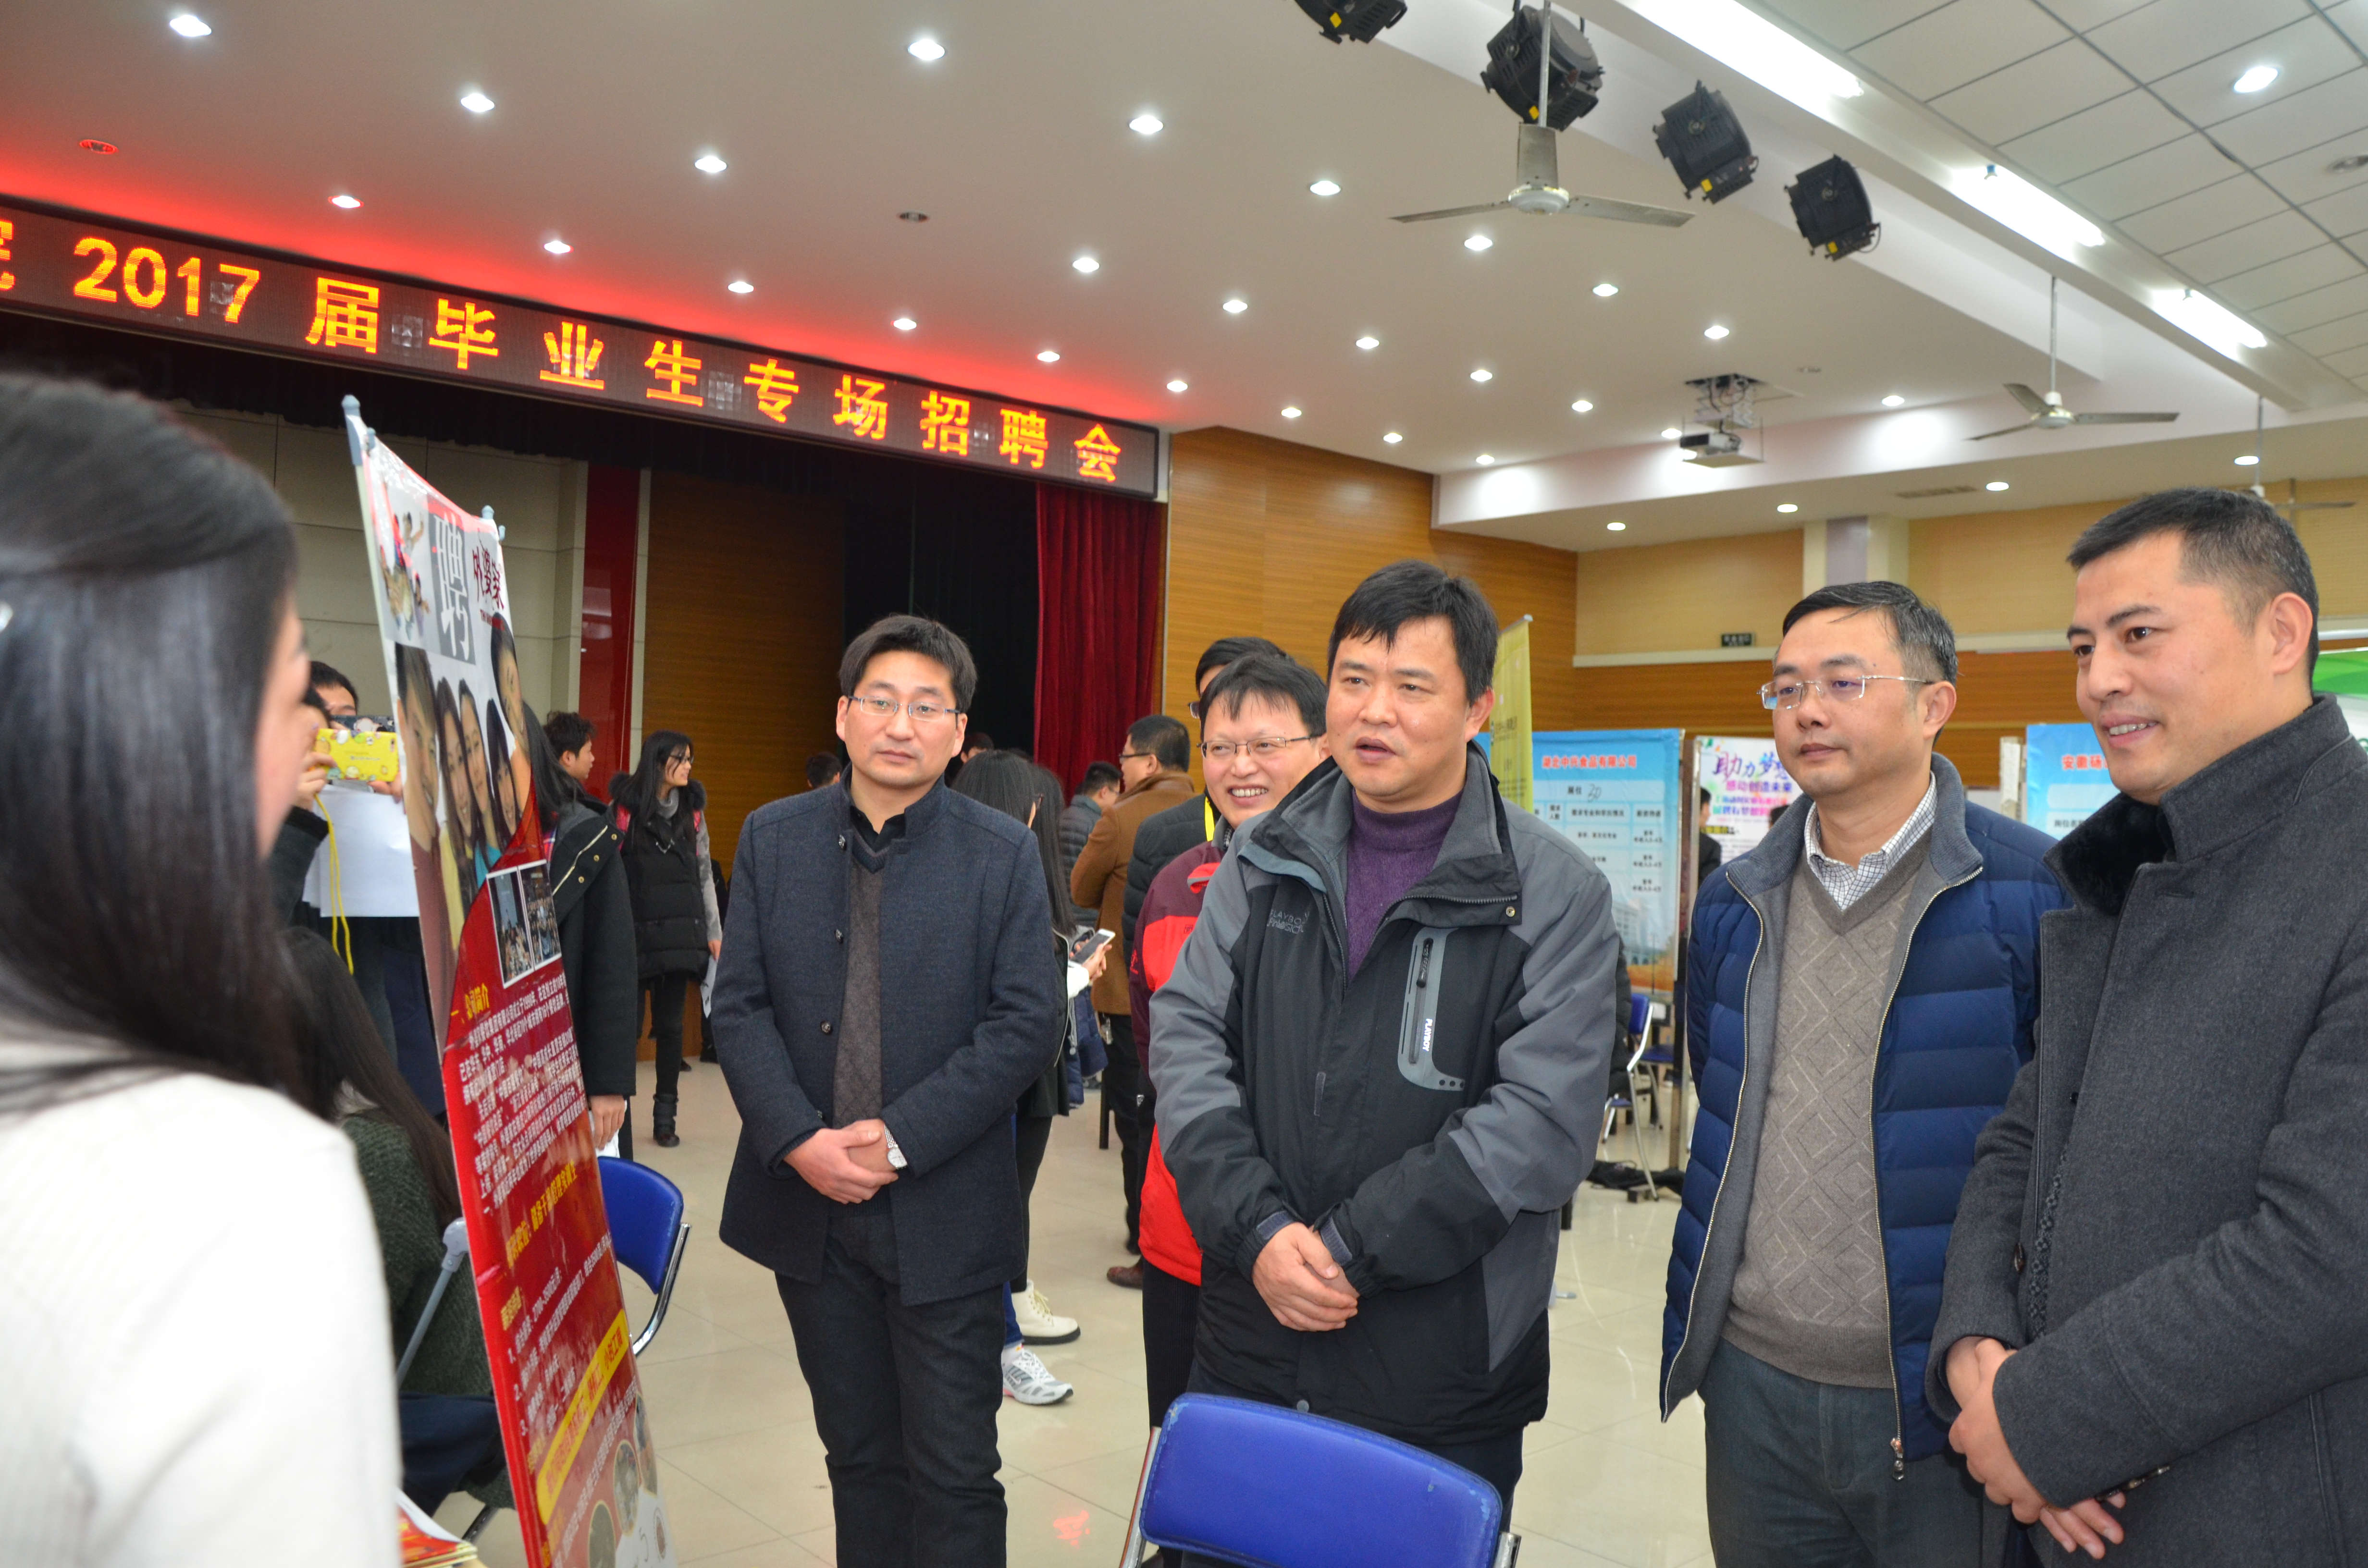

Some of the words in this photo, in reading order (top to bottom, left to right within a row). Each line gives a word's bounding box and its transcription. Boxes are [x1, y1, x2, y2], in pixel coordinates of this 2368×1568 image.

[0, 220, 1122, 483] 2017届毕业生专场招聘会
[1422, 1018, 1432, 1052] PLAYBOY
